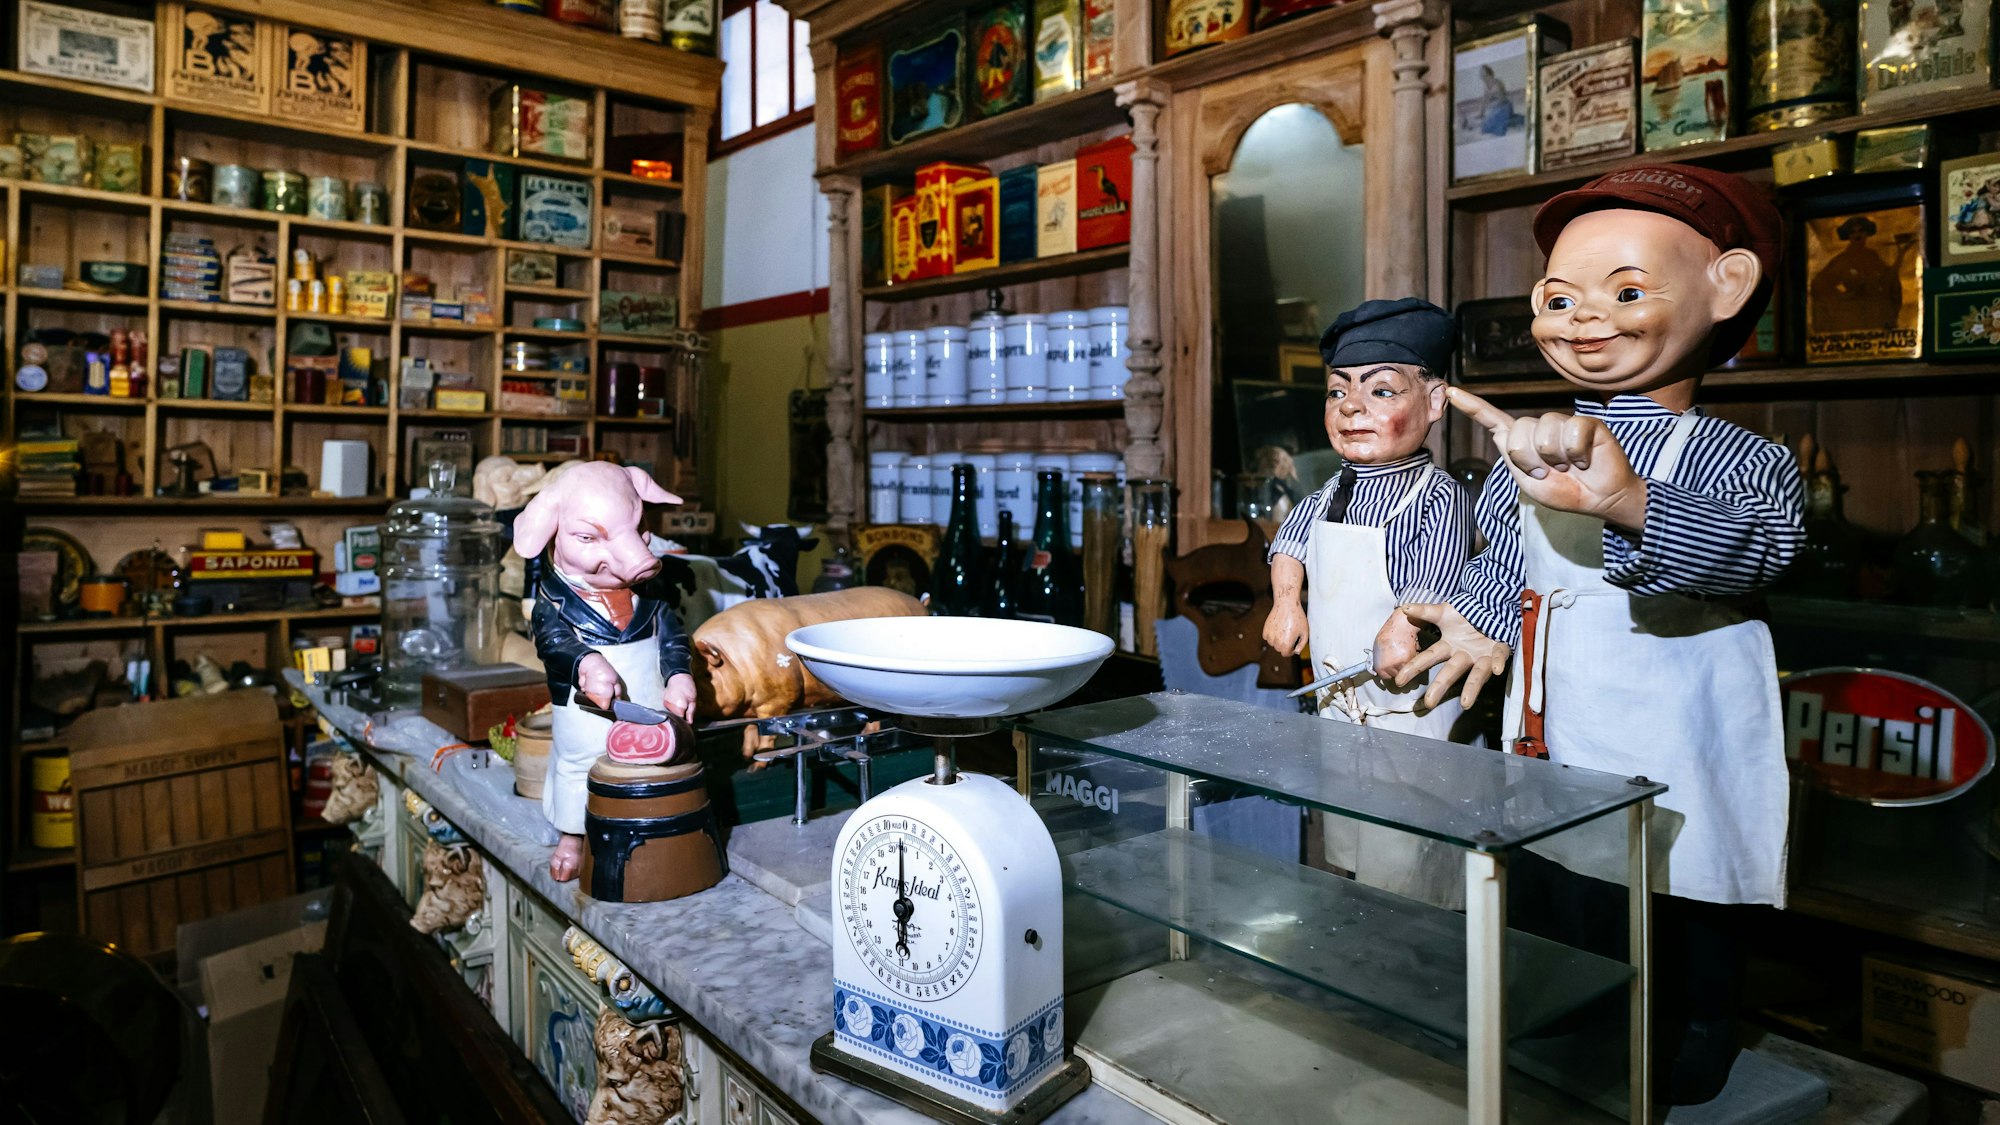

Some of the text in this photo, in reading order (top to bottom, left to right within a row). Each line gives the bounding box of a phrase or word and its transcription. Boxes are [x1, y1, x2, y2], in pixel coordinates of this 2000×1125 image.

[205, 555, 300, 570] SAPONIA
[1785, 690, 1956, 783] Persil
[1046, 770, 1119, 815] MAGGI
[883, 819, 891, 831] 10
[856, 840, 861, 850] 9
[888, 844, 896, 854] 20
[940, 843, 944, 854] 1
[878, 849, 884, 858] 19
[916, 850, 919, 859] 1
[870, 858, 876, 867] 18
[928, 861, 933, 871] 2
[864, 872, 869, 880] 17
[940, 875, 944, 884] 3
[844, 878, 849, 890] 8
[860, 886, 867, 895] 16
[964, 886, 970, 899] 2
[947, 893, 952, 901] 4
[861, 903, 867, 911] 15
[951, 910, 955, 918] 5
[866, 920, 872, 929] 14
[853, 926, 858, 937] 7
[950, 928, 954, 936] 6
[874, 936, 882, 944] 13
[968, 936, 975, 948] 3
[945, 942, 949, 951] 7
[886, 948, 892, 958] 12
[899, 958, 904, 967] 11
[938, 954, 942, 963] 8
[912, 962, 918, 971] 10
[927, 961, 931, 969] 9
[878, 966, 884, 977] 6
[949, 974, 957, 985] 4
[916, 986, 922, 997] 5
